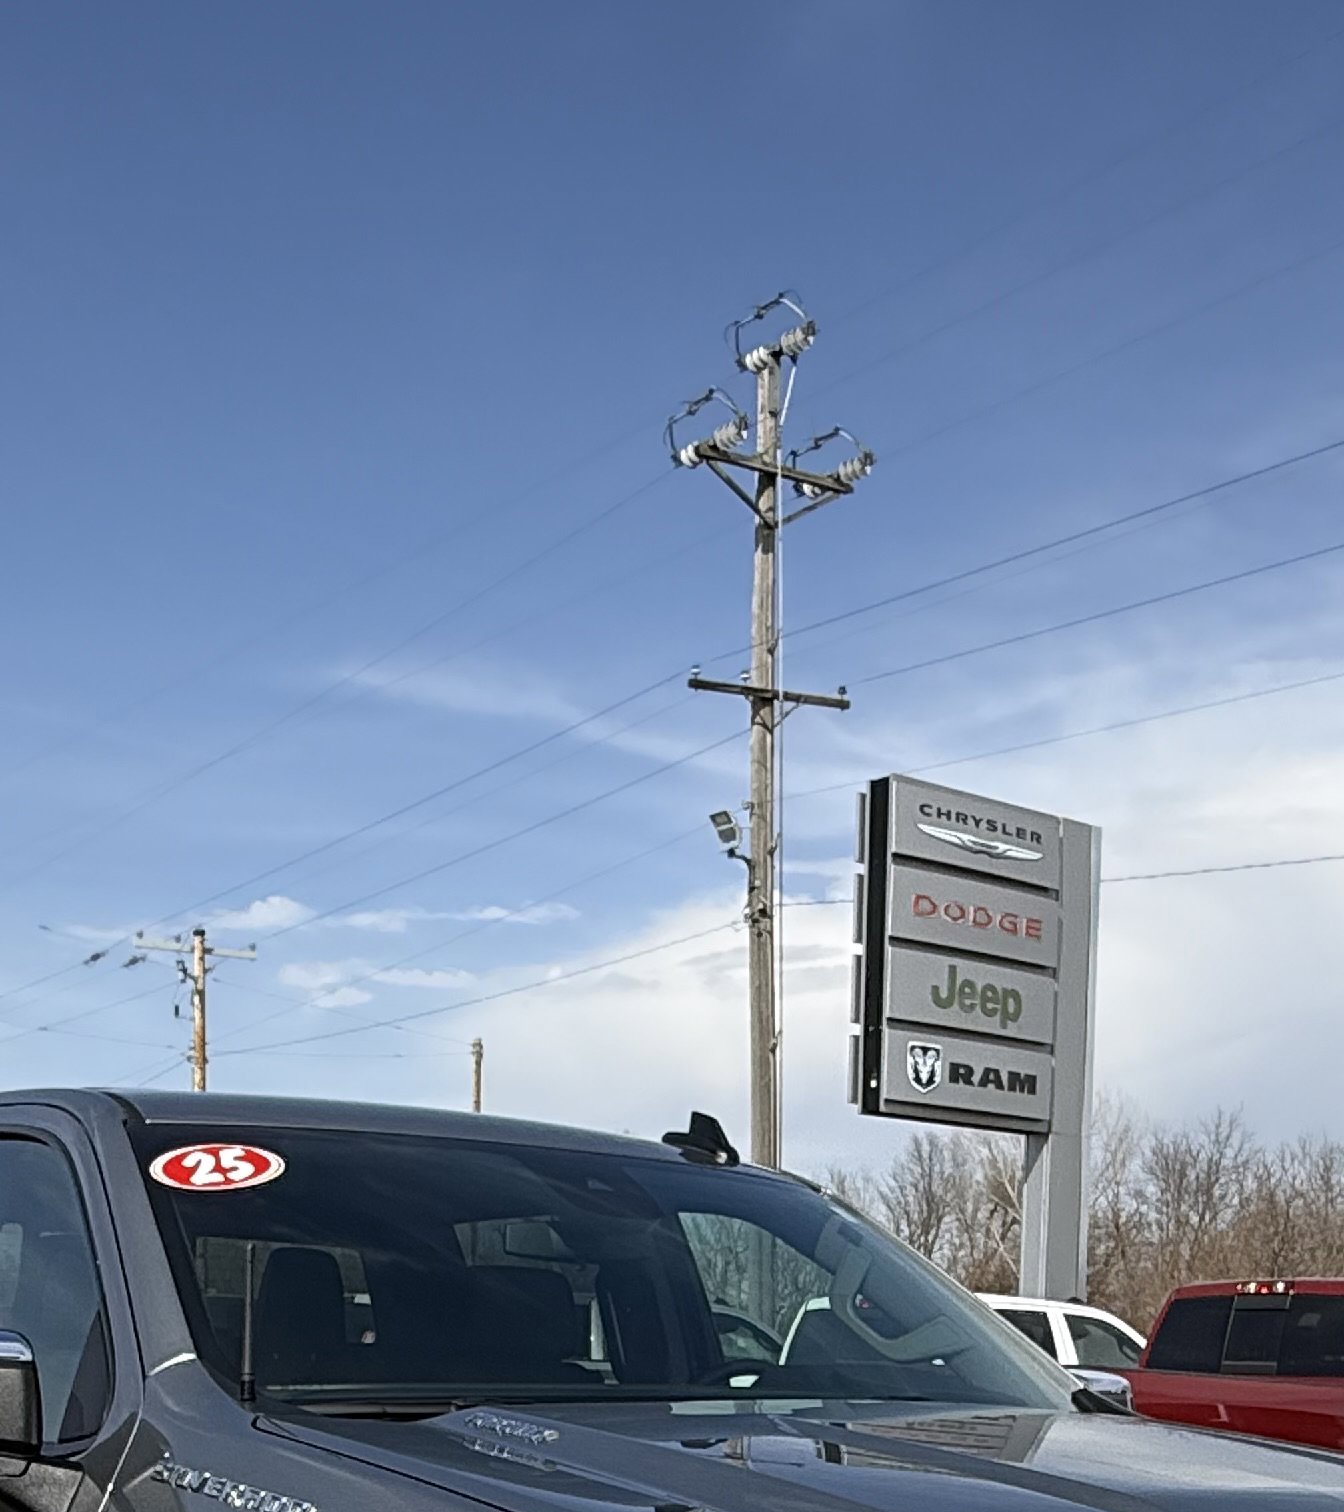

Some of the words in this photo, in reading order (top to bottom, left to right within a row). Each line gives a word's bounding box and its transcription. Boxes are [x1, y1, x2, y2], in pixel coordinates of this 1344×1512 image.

[918, 803, 1043, 845] CHRYSLER
[912, 893, 1043, 941] DODGE
[931, 964, 1023, 1029] Jeep
[948, 1062, 1038, 1095] RAM
[180, 1147, 256, 1186] 25
